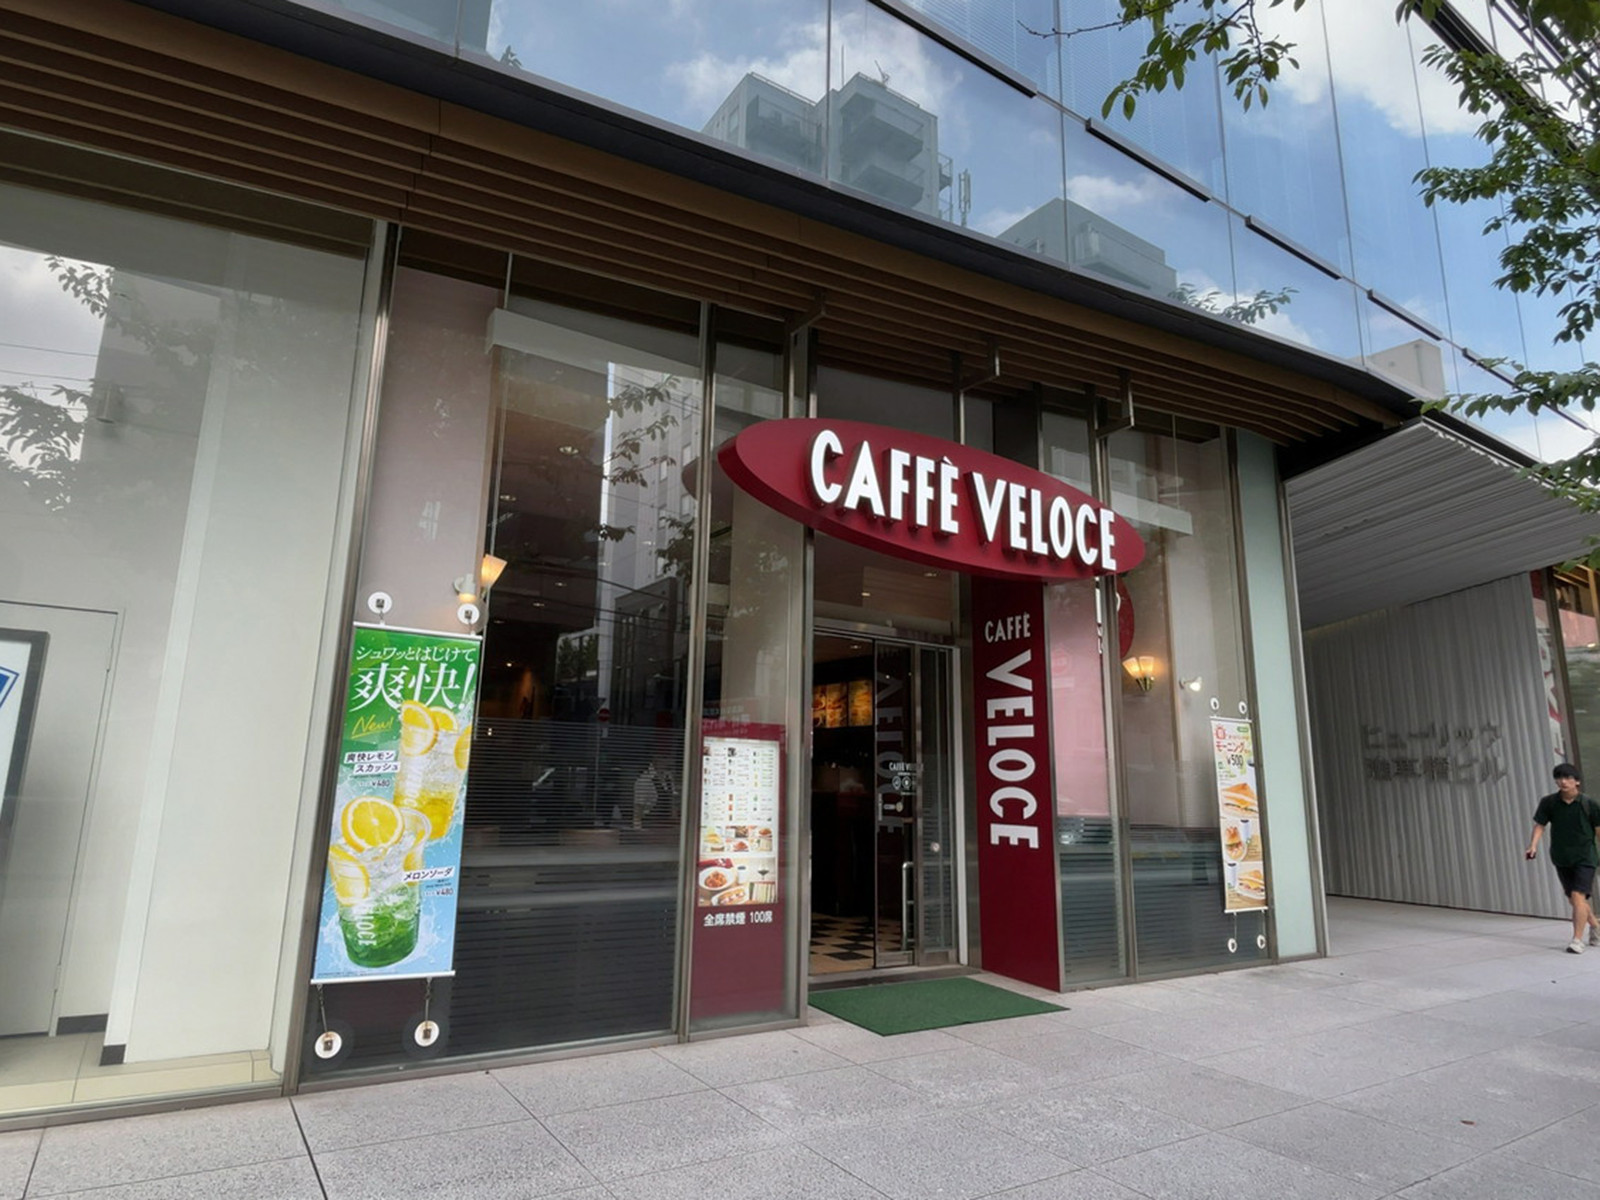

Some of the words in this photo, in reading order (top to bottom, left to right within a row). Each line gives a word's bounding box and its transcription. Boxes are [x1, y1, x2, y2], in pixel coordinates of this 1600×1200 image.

[811, 430, 959, 534] CAFFÈ
[971, 471, 1117, 571] VELOCE
[356, 646, 477, 662] シュワッとはじけて
[352, 714, 394, 737] New!
[986, 648, 1039, 849] VELOCE
[346, 752, 394, 763] 爽快レモン
[355, 763, 399, 773] スカッシュ
[404, 867, 453, 881] メロンソーダ
